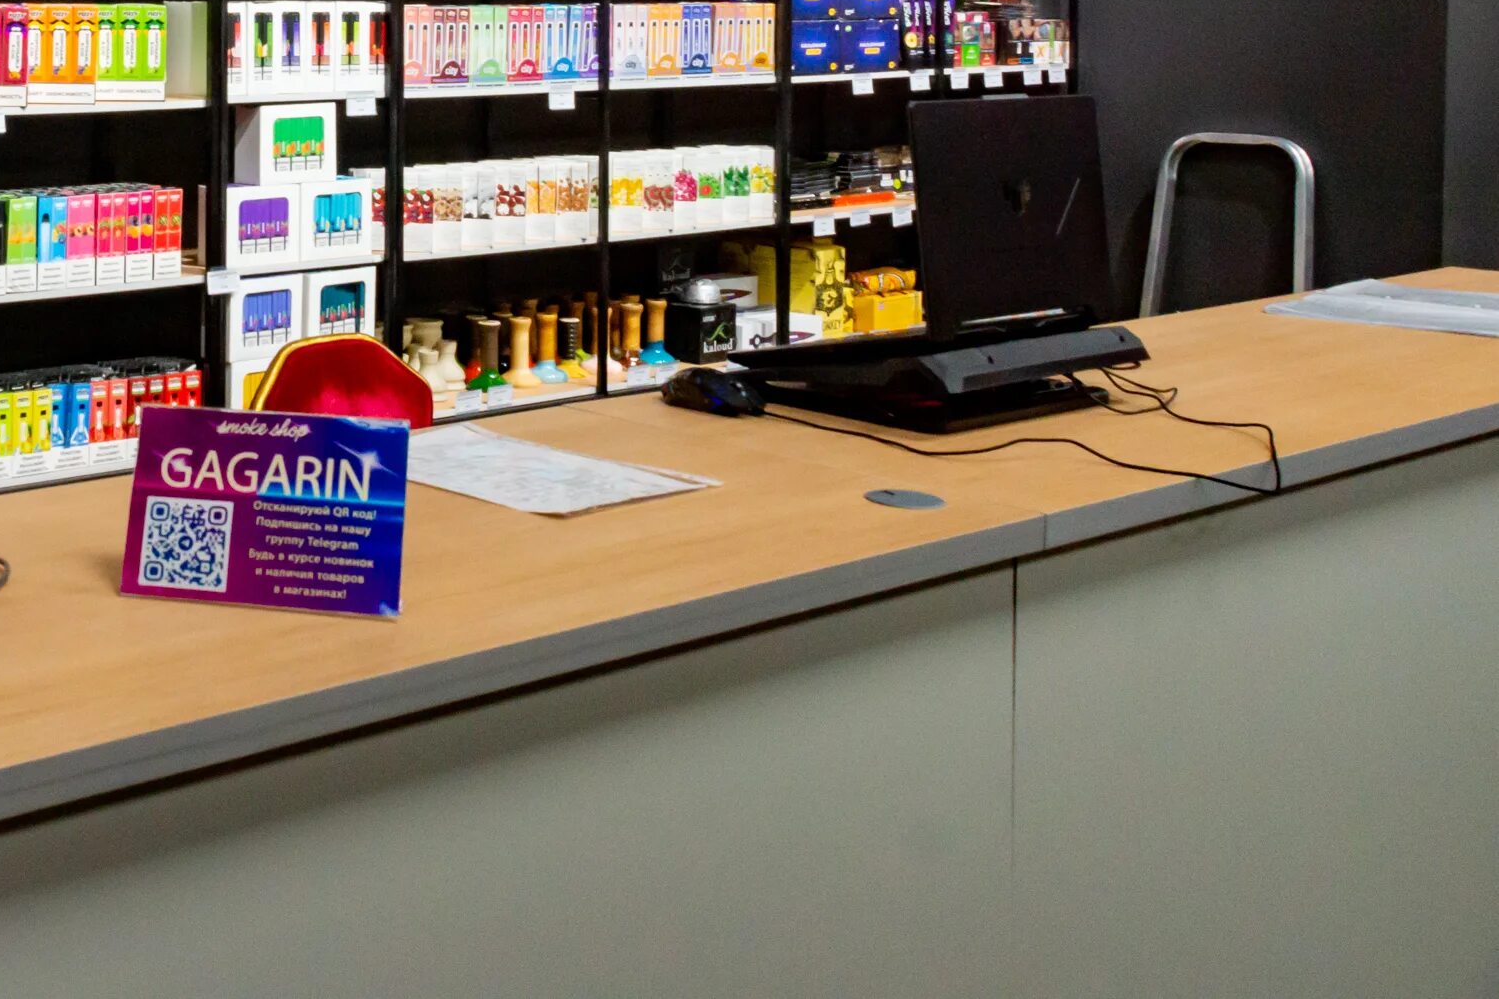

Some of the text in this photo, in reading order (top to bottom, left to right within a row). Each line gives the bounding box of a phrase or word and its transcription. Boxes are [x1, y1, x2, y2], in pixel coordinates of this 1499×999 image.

[703, 338, 734, 354] kaloud
[217, 418, 311, 443] smoke shop
[160, 447, 372, 502] GAGARIN
[333, 507, 350, 518] QR
[352, 509, 377, 521] код!
[256, 516, 372, 538] Подпишись на нашу
[266, 535, 359, 551] группу Telegram
[249, 548, 276, 562] Будь
[288, 553, 321, 565] курсе
[323, 556, 375, 569] новинок
[265, 568, 314, 580] наличия
[317, 572, 365, 585] товаров
[283, 586, 347, 600] магазинах!
